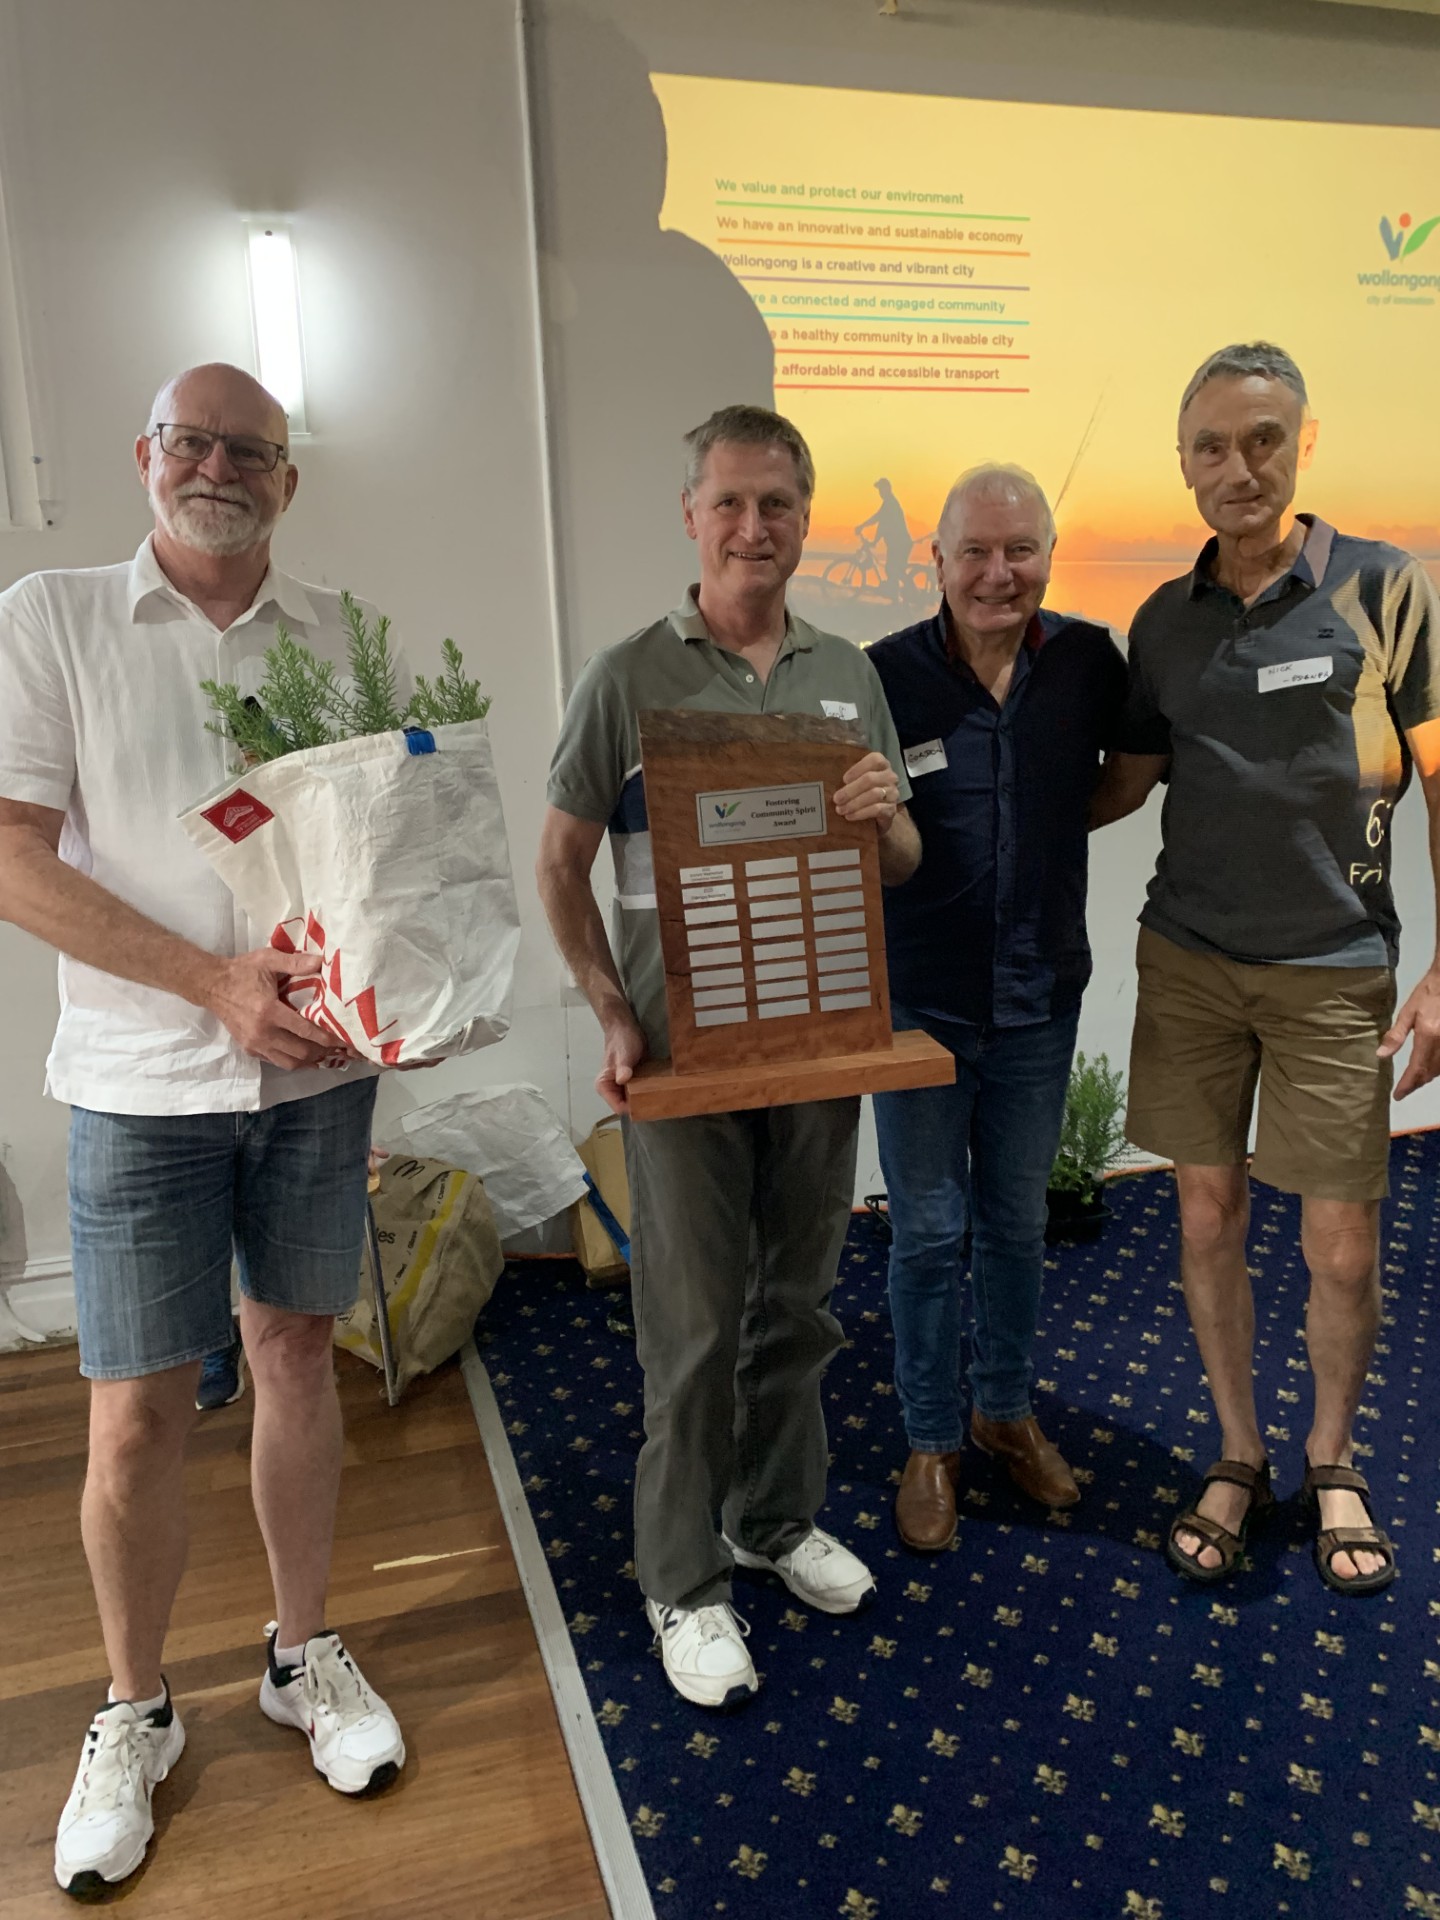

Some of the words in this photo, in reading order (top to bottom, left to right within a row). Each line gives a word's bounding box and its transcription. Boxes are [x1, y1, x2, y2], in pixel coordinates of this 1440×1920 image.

[715, 178, 737, 191] We
[742, 181, 777, 193] value
[781, 184, 805, 195] and
[809, 186, 857, 199] protect
[861, 190, 882, 200] our
[886, 190, 964, 204] environment
[717, 216, 738, 229] We
[743, 218, 774, 231] have
[778, 221, 794, 232] an
[798, 221, 864, 235] innovative
[867, 225, 891, 237] and
[895, 227, 964, 240] sustainable
[968, 231, 1023, 245] economy
[718, 253, 798, 271] Wollongong
[802, 257, 812, 269] is
[816, 260, 823, 270] a
[826, 259, 876, 272] creative
[879, 261, 902, 273] and
[906, 262, 949, 275] vibrant
[952, 264, 975, 278] city
[752, 294, 766, 304] re
[770, 295, 778, 304] a
[782, 295, 849, 306] connected
[853, 296, 876, 307] and
[880, 298, 935, 311] engaged
[938, 300, 1005, 314] community
[780, 330, 789, 340] a
[793, 328, 839, 343] healthy
[843, 331, 913, 345] community
[917, 332, 928, 344] in
[931, 334, 939, 344] a
[942, 332, 988, 345] liveable
[992, 334, 1014, 348] city
[782, 363, 848, 376] affordable
[851, 366, 875, 377] and
[879, 367, 941, 379] accessible
[945, 367, 1000, 380] transport
[750, 807, 794, 819] Community
[795, 806, 816, 816] Spirit
[765, 798, 800, 807] Fostering
[773, 819, 797, 827] Award
